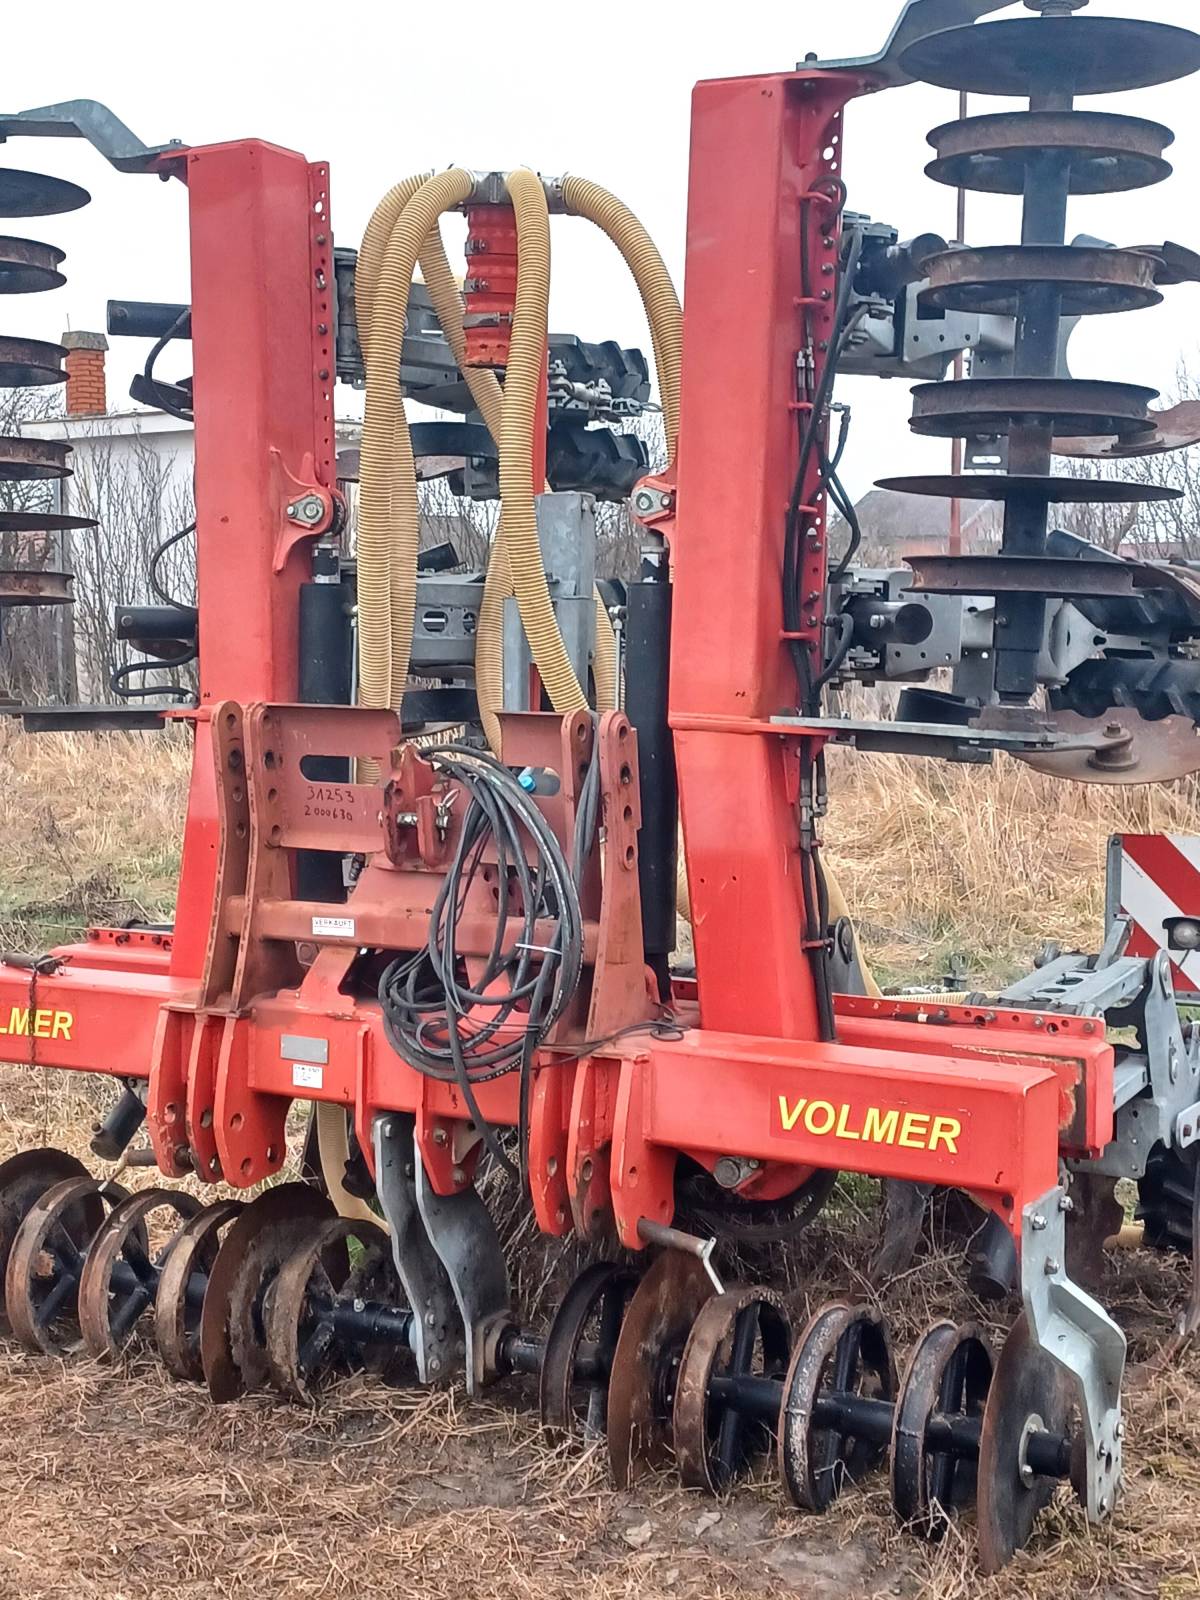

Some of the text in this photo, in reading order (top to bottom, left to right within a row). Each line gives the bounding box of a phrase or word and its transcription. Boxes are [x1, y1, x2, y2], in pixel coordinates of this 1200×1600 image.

[307, 785, 354, 803] 31253
[304, 804, 353, 821] 2000630
[778, 1095, 962, 1154] VOLMER
